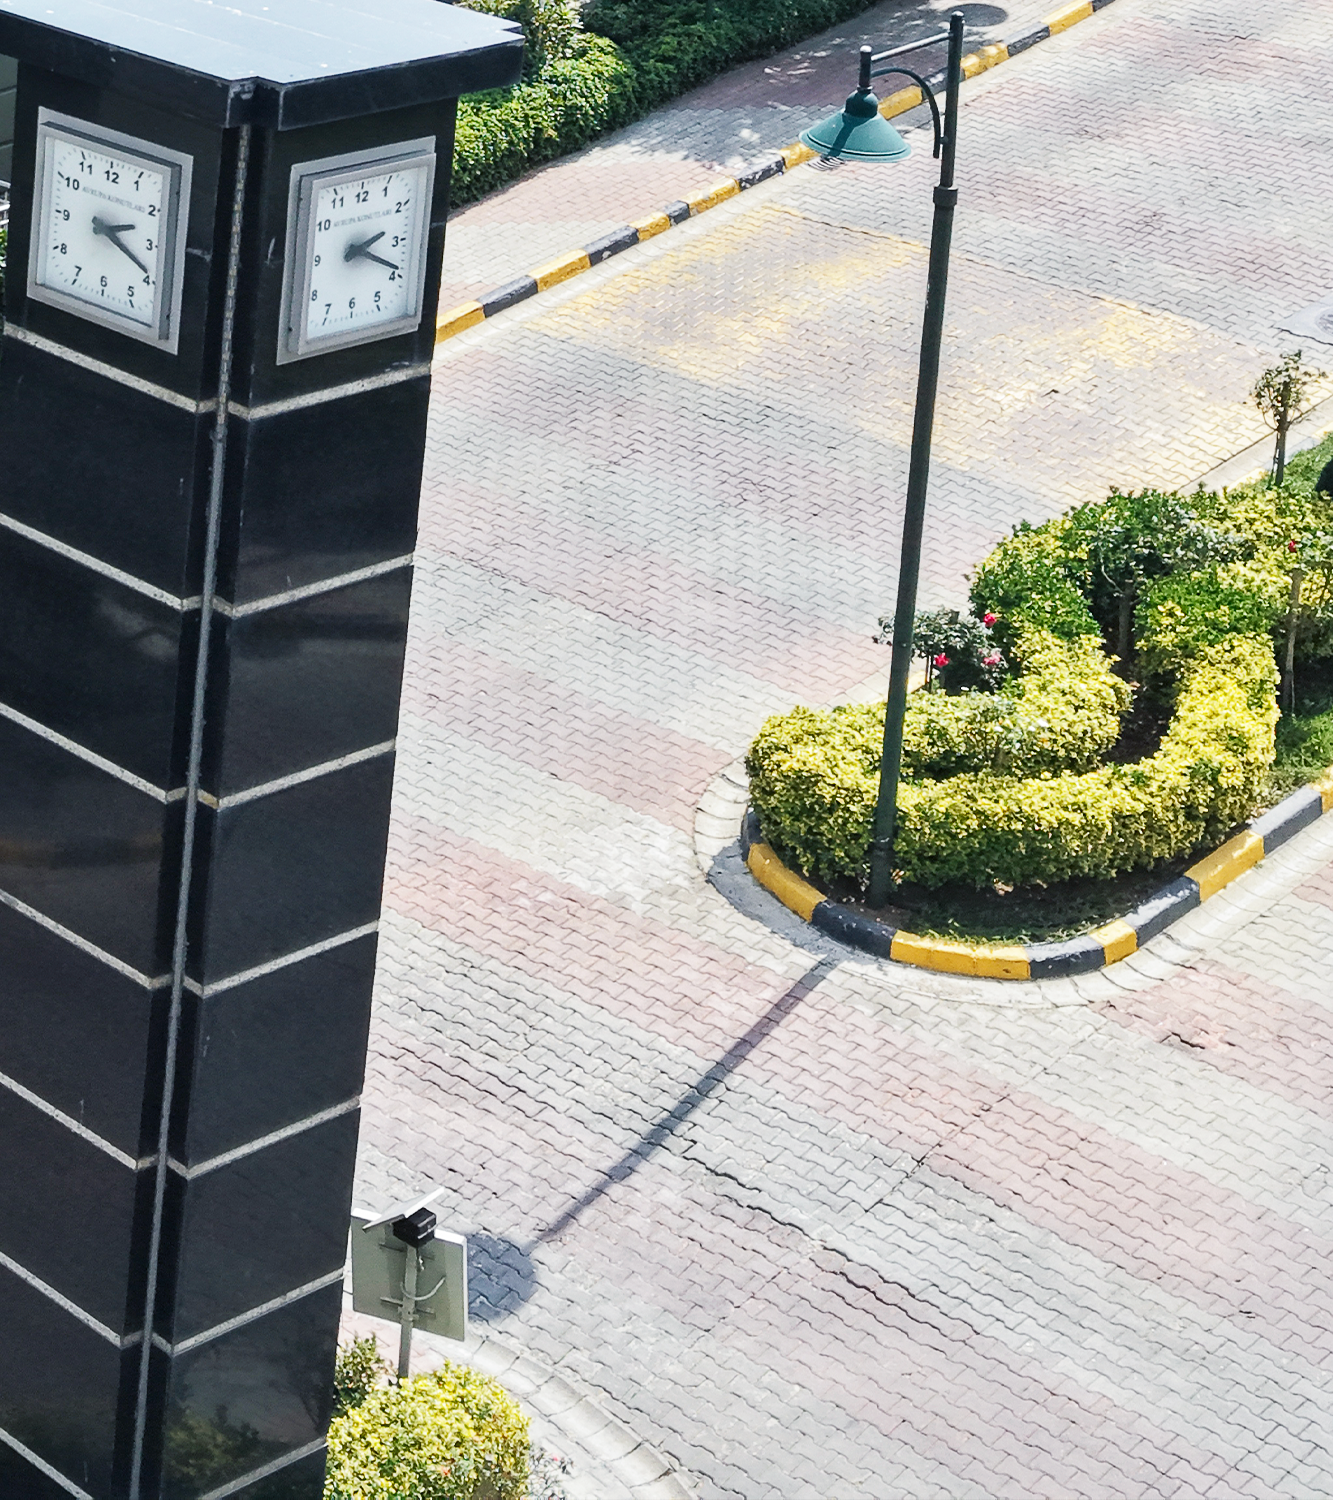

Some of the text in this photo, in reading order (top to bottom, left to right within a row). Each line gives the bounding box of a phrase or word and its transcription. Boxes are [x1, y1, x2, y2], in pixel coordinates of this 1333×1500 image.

[79, 161, 93, 175] 11
[104, 170, 120, 184] 12
[64, 177, 80, 191] 10
[134, 180, 140, 191] 1
[355, 190, 369, 204] 12
[382, 186, 389, 197] 1
[331, 196, 345, 209] 11
[395, 201, 402, 214] 2
[62, 209, 70, 221] 9
[148, 204, 156, 217] 2
[317, 219, 331, 232] 10
[146, 239, 154, 251] 3
[391, 235, 399, 248] 3
[60, 243, 68, 255] 8
[314, 255, 321, 267] 9
[74, 265, 82, 277] 7
[388, 270, 396, 281] 4
[100, 275, 108, 287] 6
[143, 275, 151, 286] 4
[127, 285, 135, 297] 5
[311, 289, 318, 302] 8
[373, 291, 381, 303] 5
[324, 303, 332, 315] 7
[348, 297, 356, 309] 6
